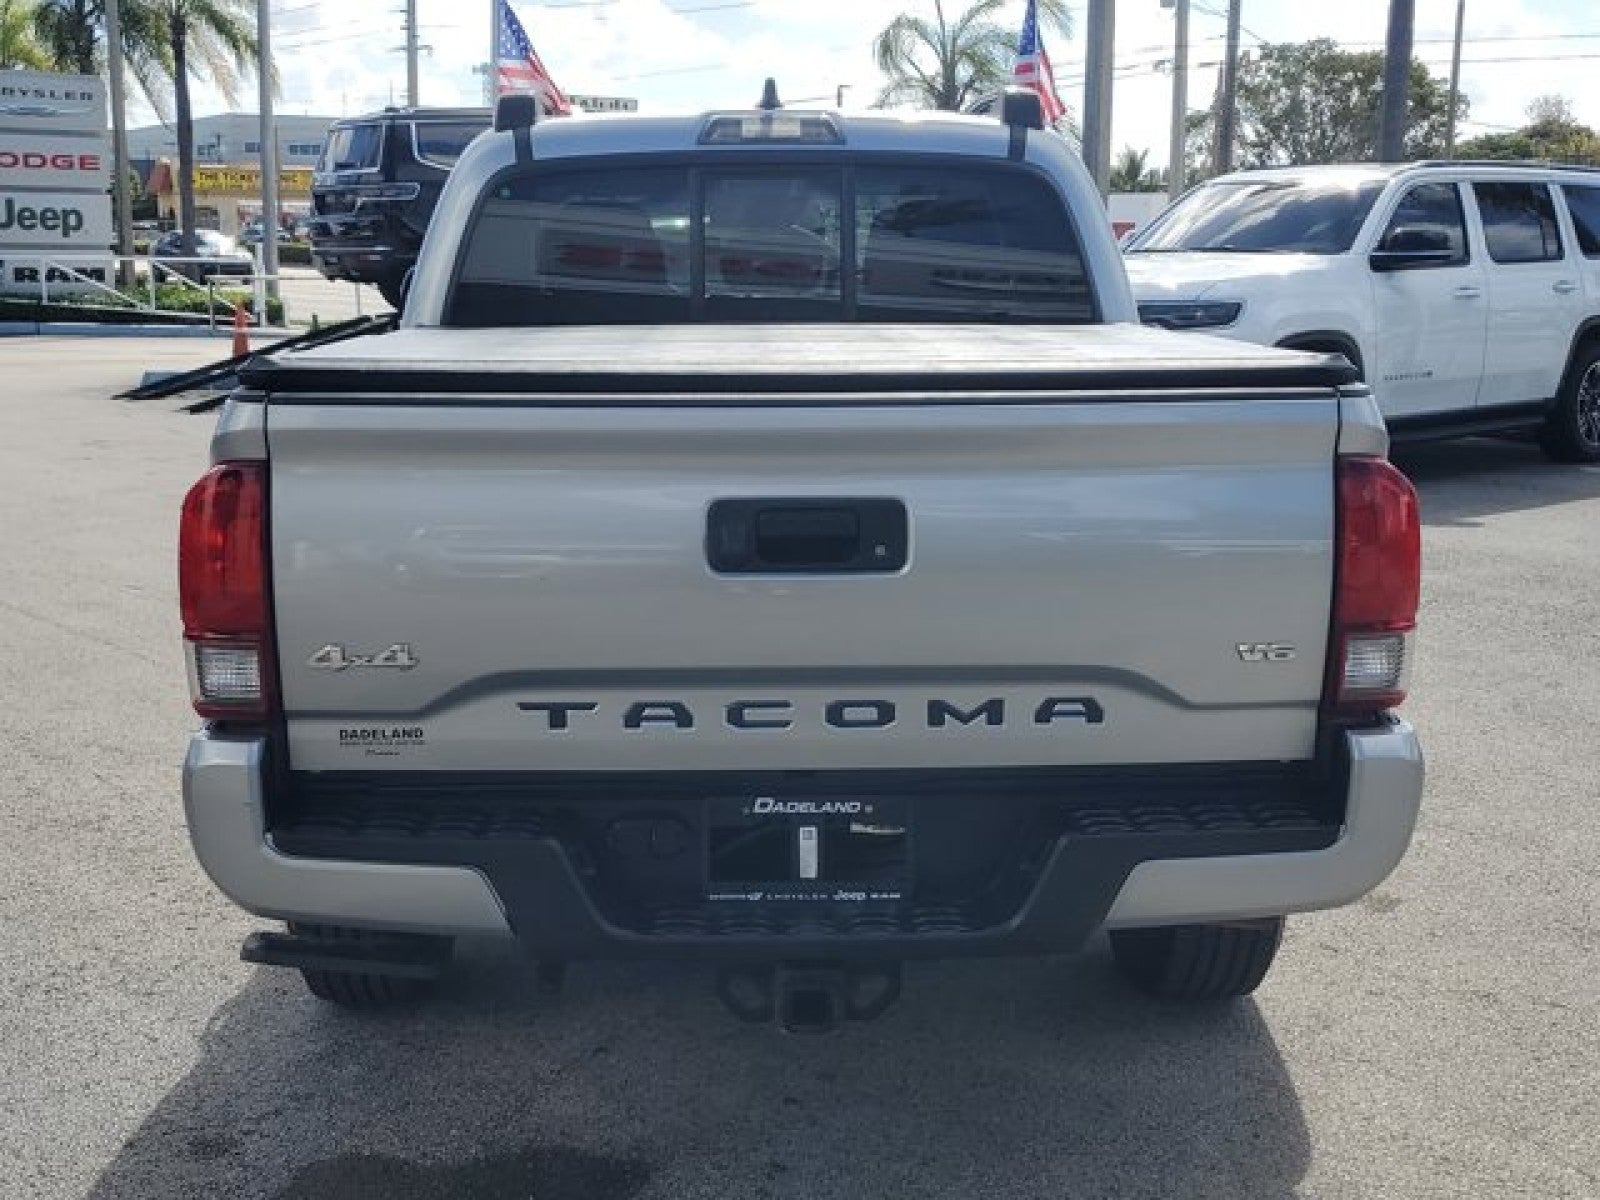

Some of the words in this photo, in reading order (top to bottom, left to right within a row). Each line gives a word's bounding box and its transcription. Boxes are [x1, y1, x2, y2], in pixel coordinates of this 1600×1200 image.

[0, 197, 83, 238] Jeep
[14, 266, 106, 283] RAM
[1235, 642, 1296, 662] V6
[517, 697, 1105, 730] TACOMA
[339, 728, 424, 741] DADELAND
